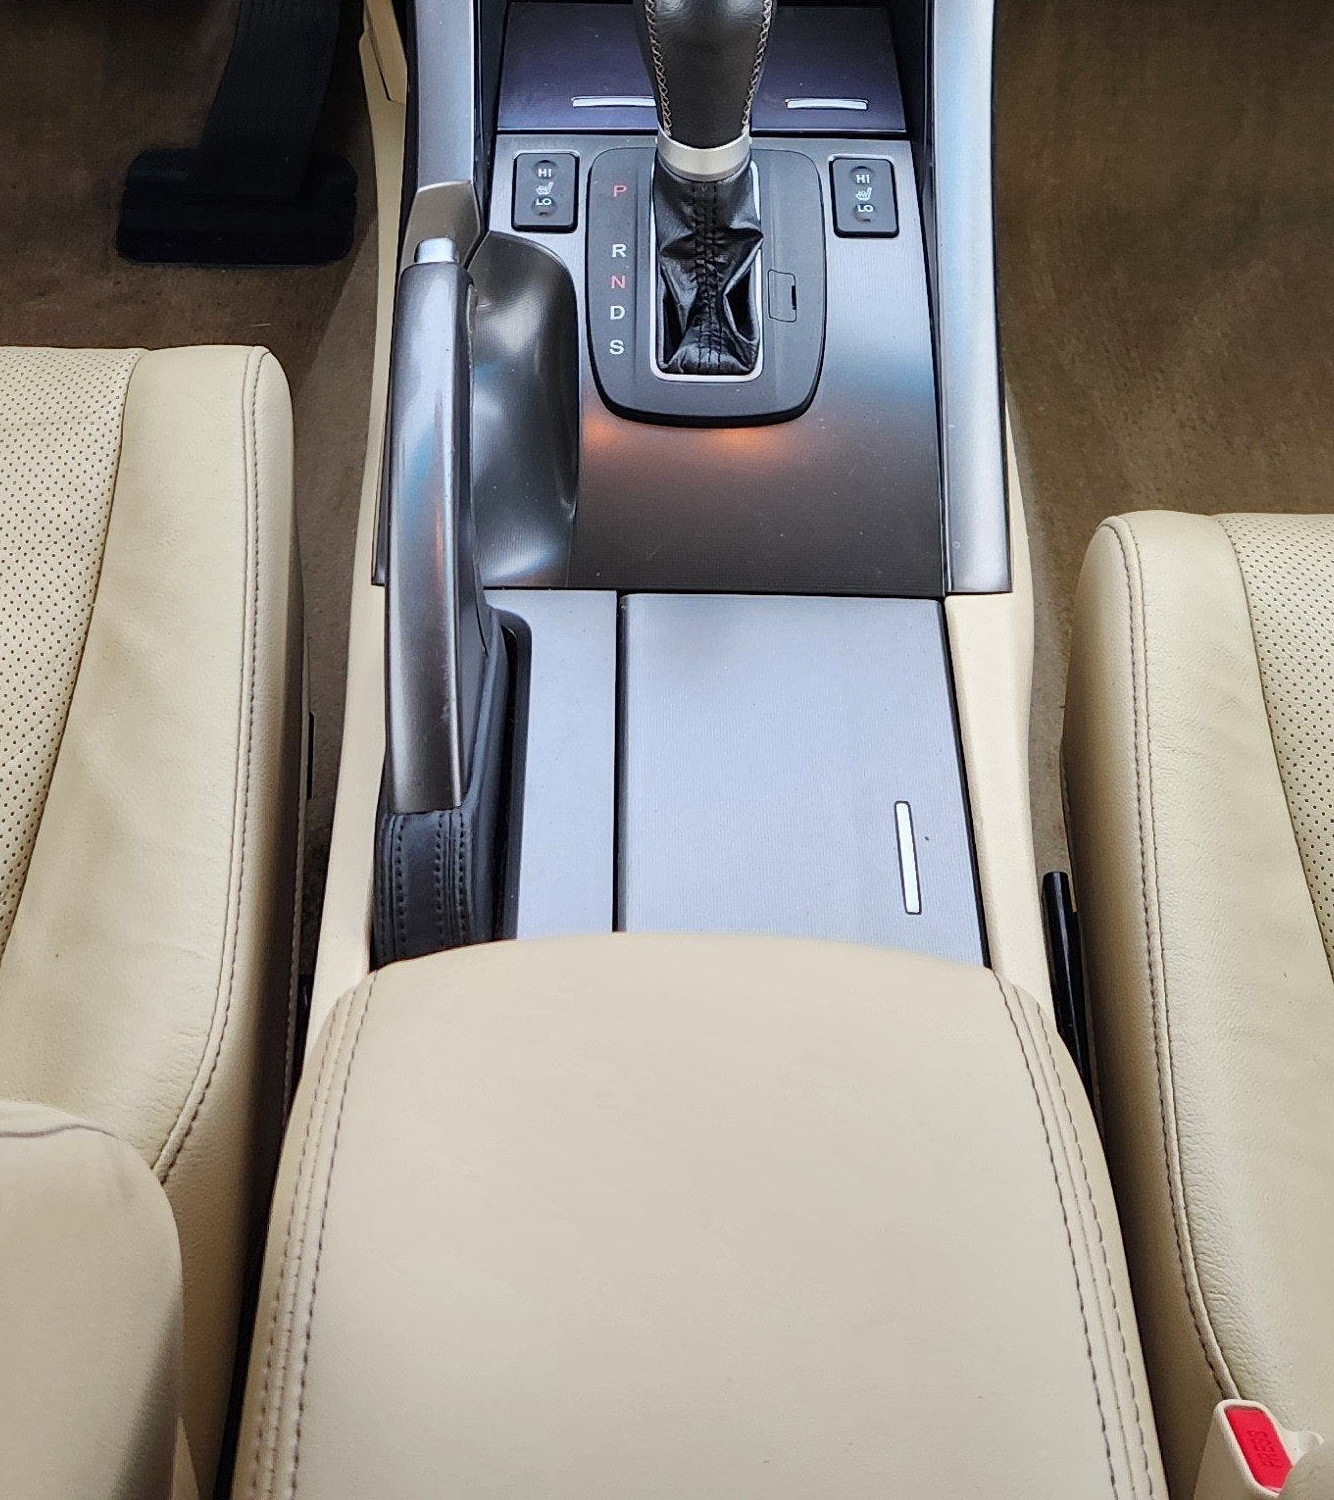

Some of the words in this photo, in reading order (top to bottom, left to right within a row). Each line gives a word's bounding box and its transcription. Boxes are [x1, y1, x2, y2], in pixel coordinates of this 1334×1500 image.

[538, 168, 552, 178] HI
[856, 174, 871, 184] HI
[613, 185, 627, 197] P
[536, 198, 552, 206] LO
[857, 204, 874, 213] LO
[612, 243, 627, 258] R
[611, 275, 626, 289] N
[610, 305, 626, 320] D
[609, 339, 625, 355] S
